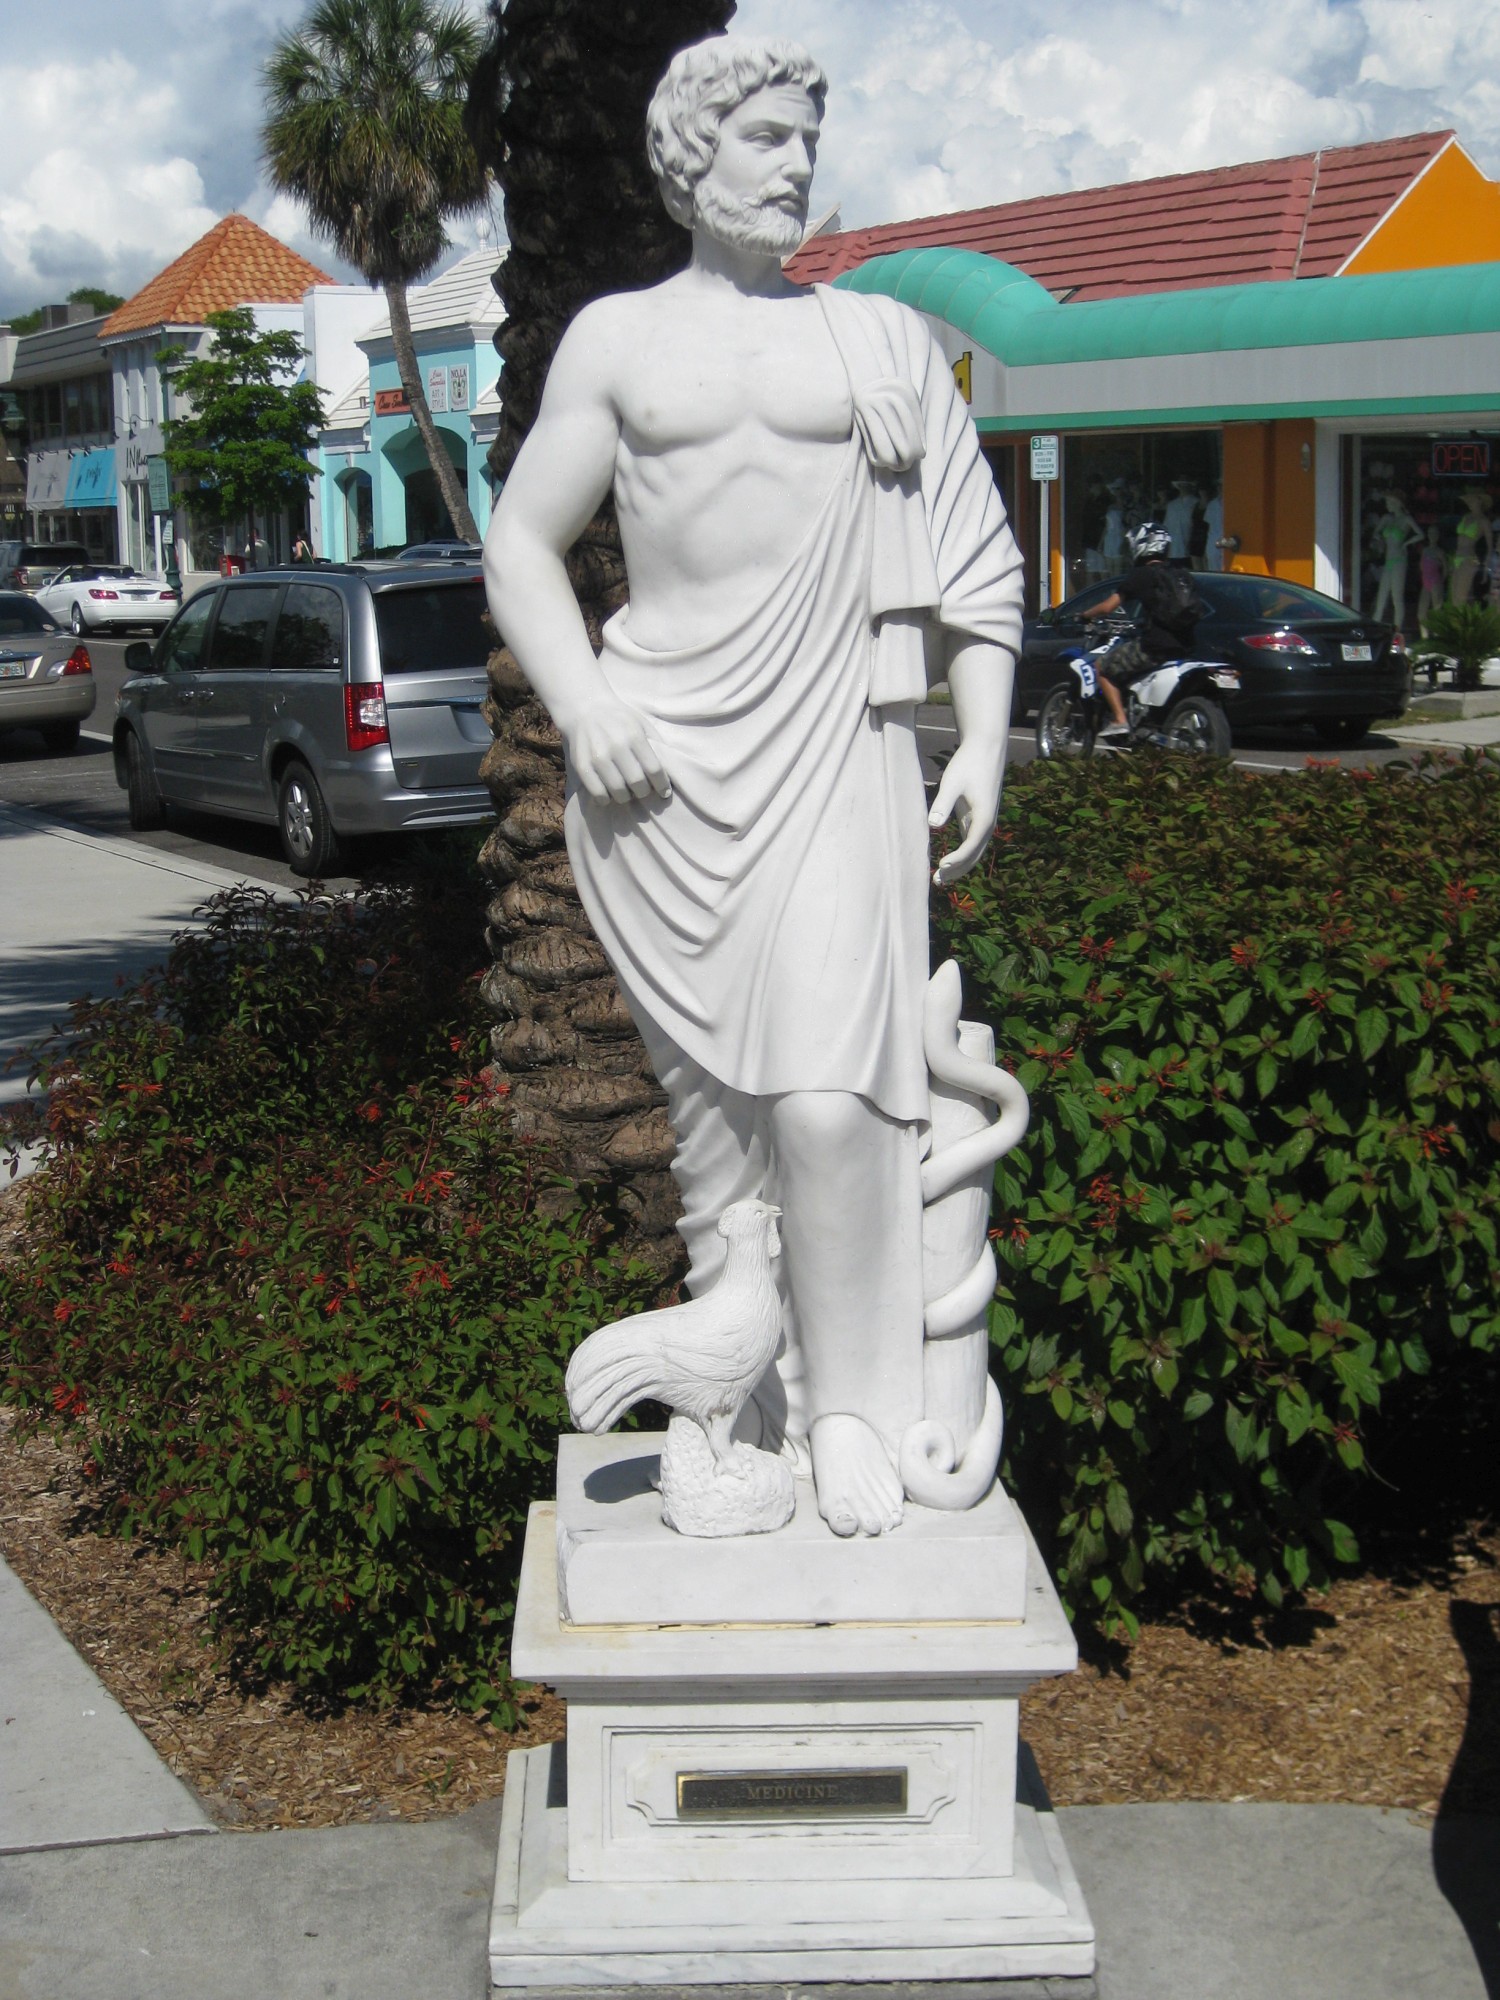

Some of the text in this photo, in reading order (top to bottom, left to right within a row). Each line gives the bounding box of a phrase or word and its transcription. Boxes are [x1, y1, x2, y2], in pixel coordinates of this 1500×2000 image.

[451, 368, 467, 378] NOLA
[1033, 438, 1040, 449] 3
[1434, 445, 1487, 473] OPEN
[747, 1785, 839, 1800] MEDICINE
